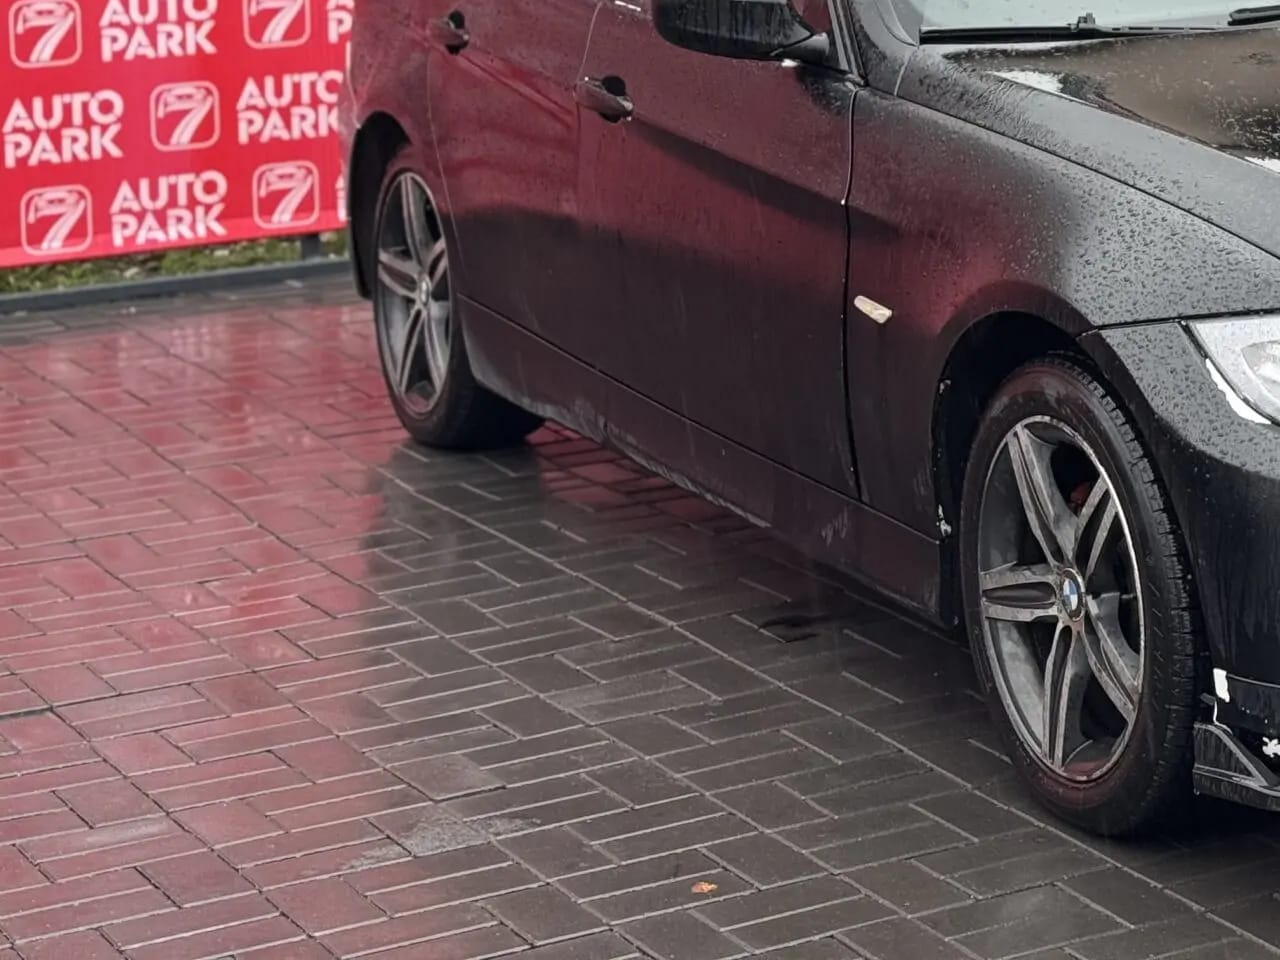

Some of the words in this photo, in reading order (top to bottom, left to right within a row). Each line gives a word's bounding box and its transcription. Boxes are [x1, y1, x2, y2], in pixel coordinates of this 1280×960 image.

[101, 20, 215, 61] PARK
[3, 90, 123, 134] AUTO
[5, 123, 122, 168] PARK
[110, 171, 227, 215] AUTO
[112, 204, 229, 248] PARK
